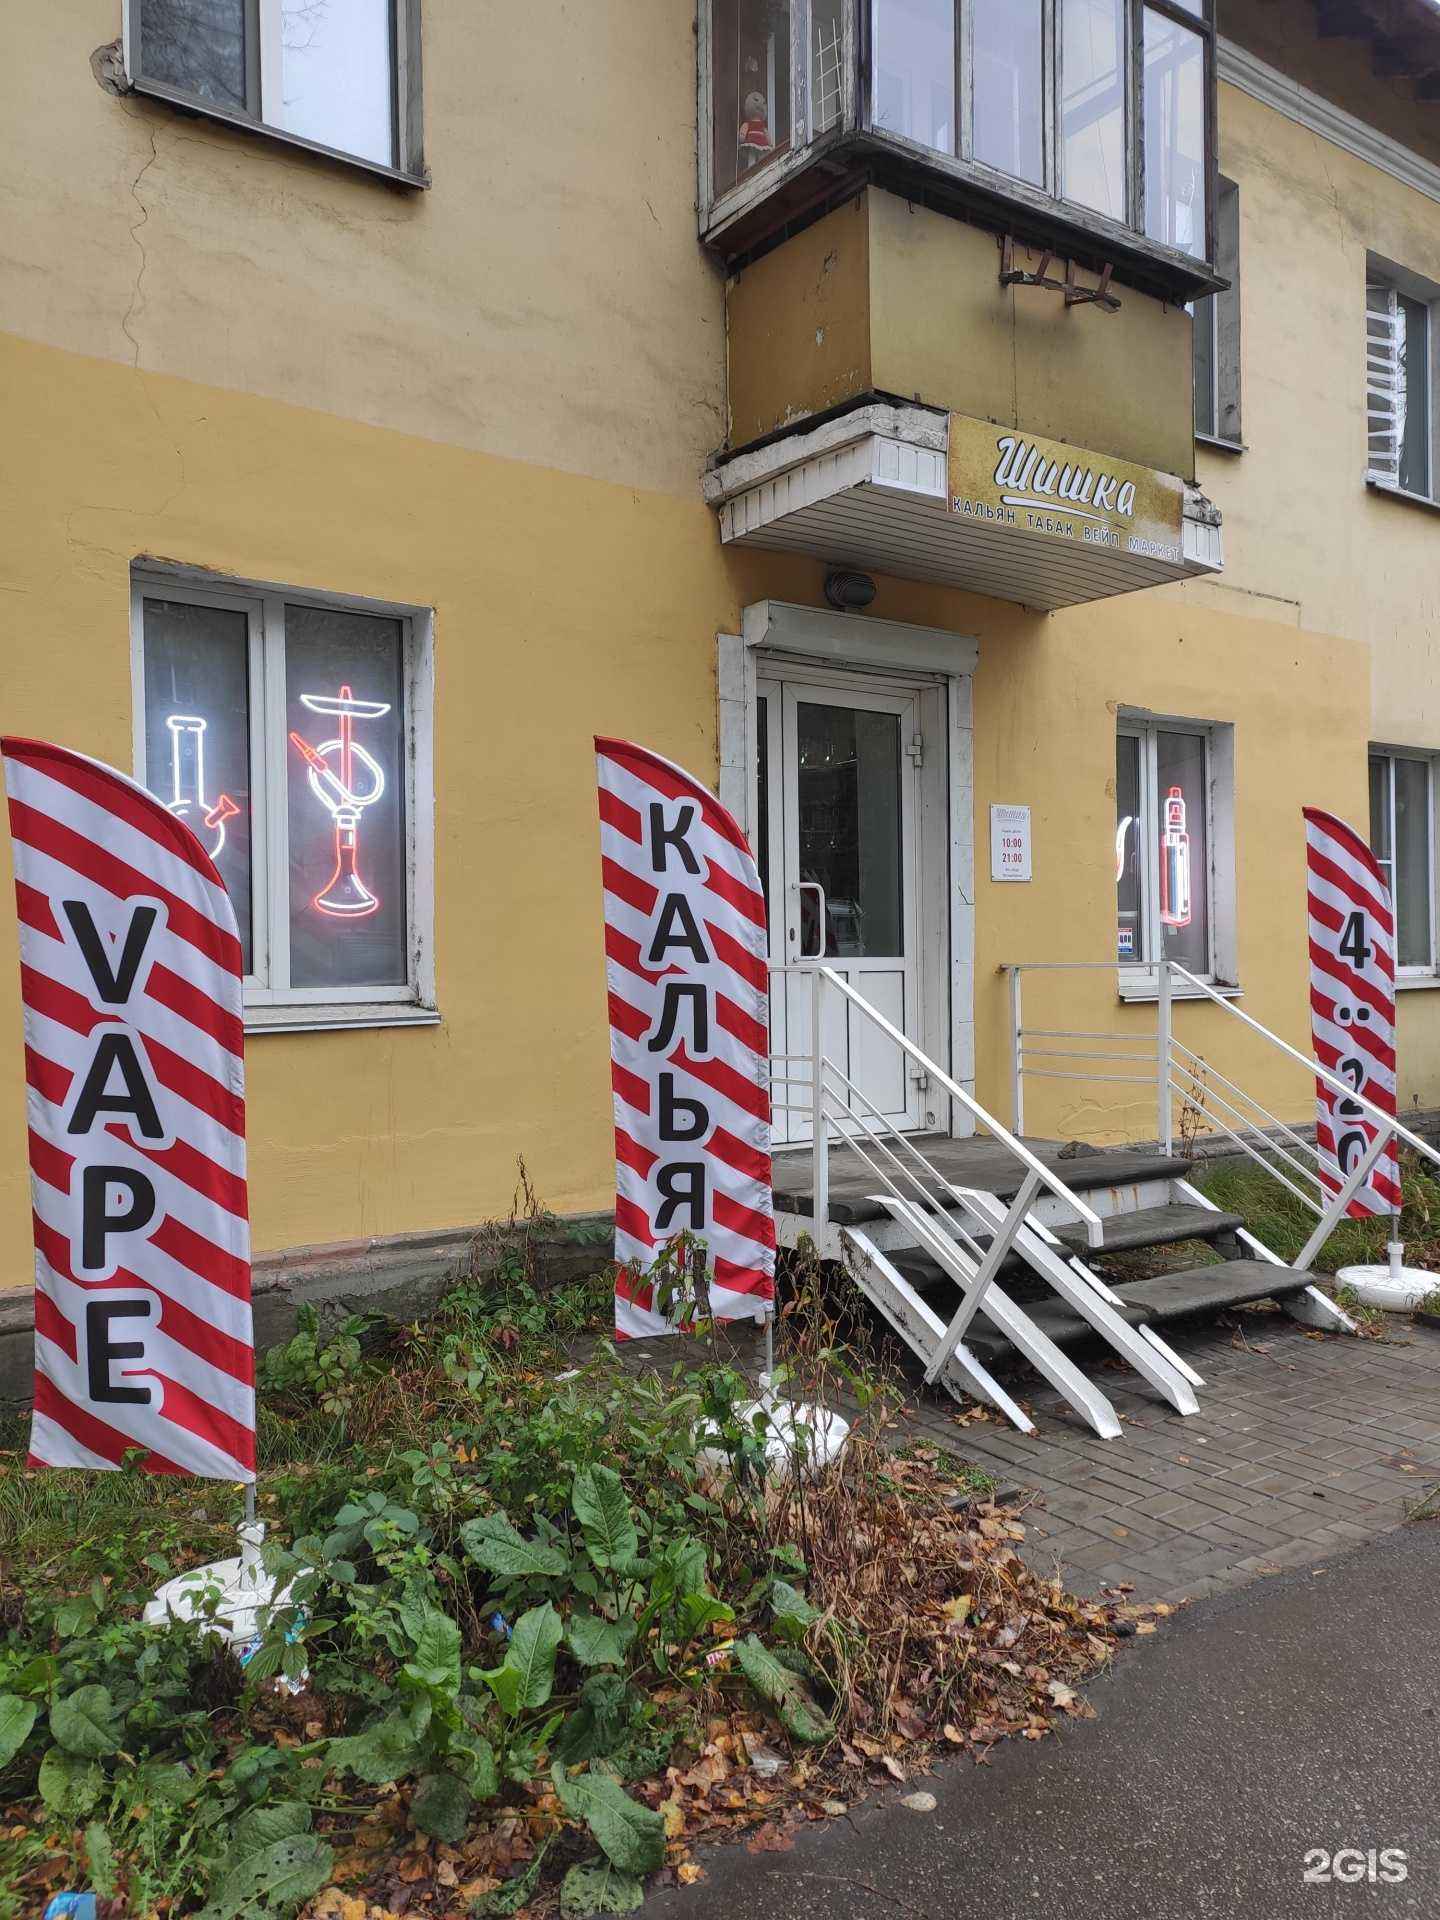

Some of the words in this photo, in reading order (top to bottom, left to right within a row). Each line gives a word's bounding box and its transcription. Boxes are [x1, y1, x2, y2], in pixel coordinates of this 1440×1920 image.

[994, 436, 1136, 517] Шишка
[952, 496, 1016, 524] КАЛЬЯН
[1026, 512, 1074, 537] ТАБАК
[1083, 526, 1120, 548] ВЕЙП
[1128, 536, 1179, 561] МАРКЕТ
[1002, 838, 1022, 848] 10:00
[1002, 852, 1023, 863] 21:00
[62, 900, 163, 1405] VAPE
